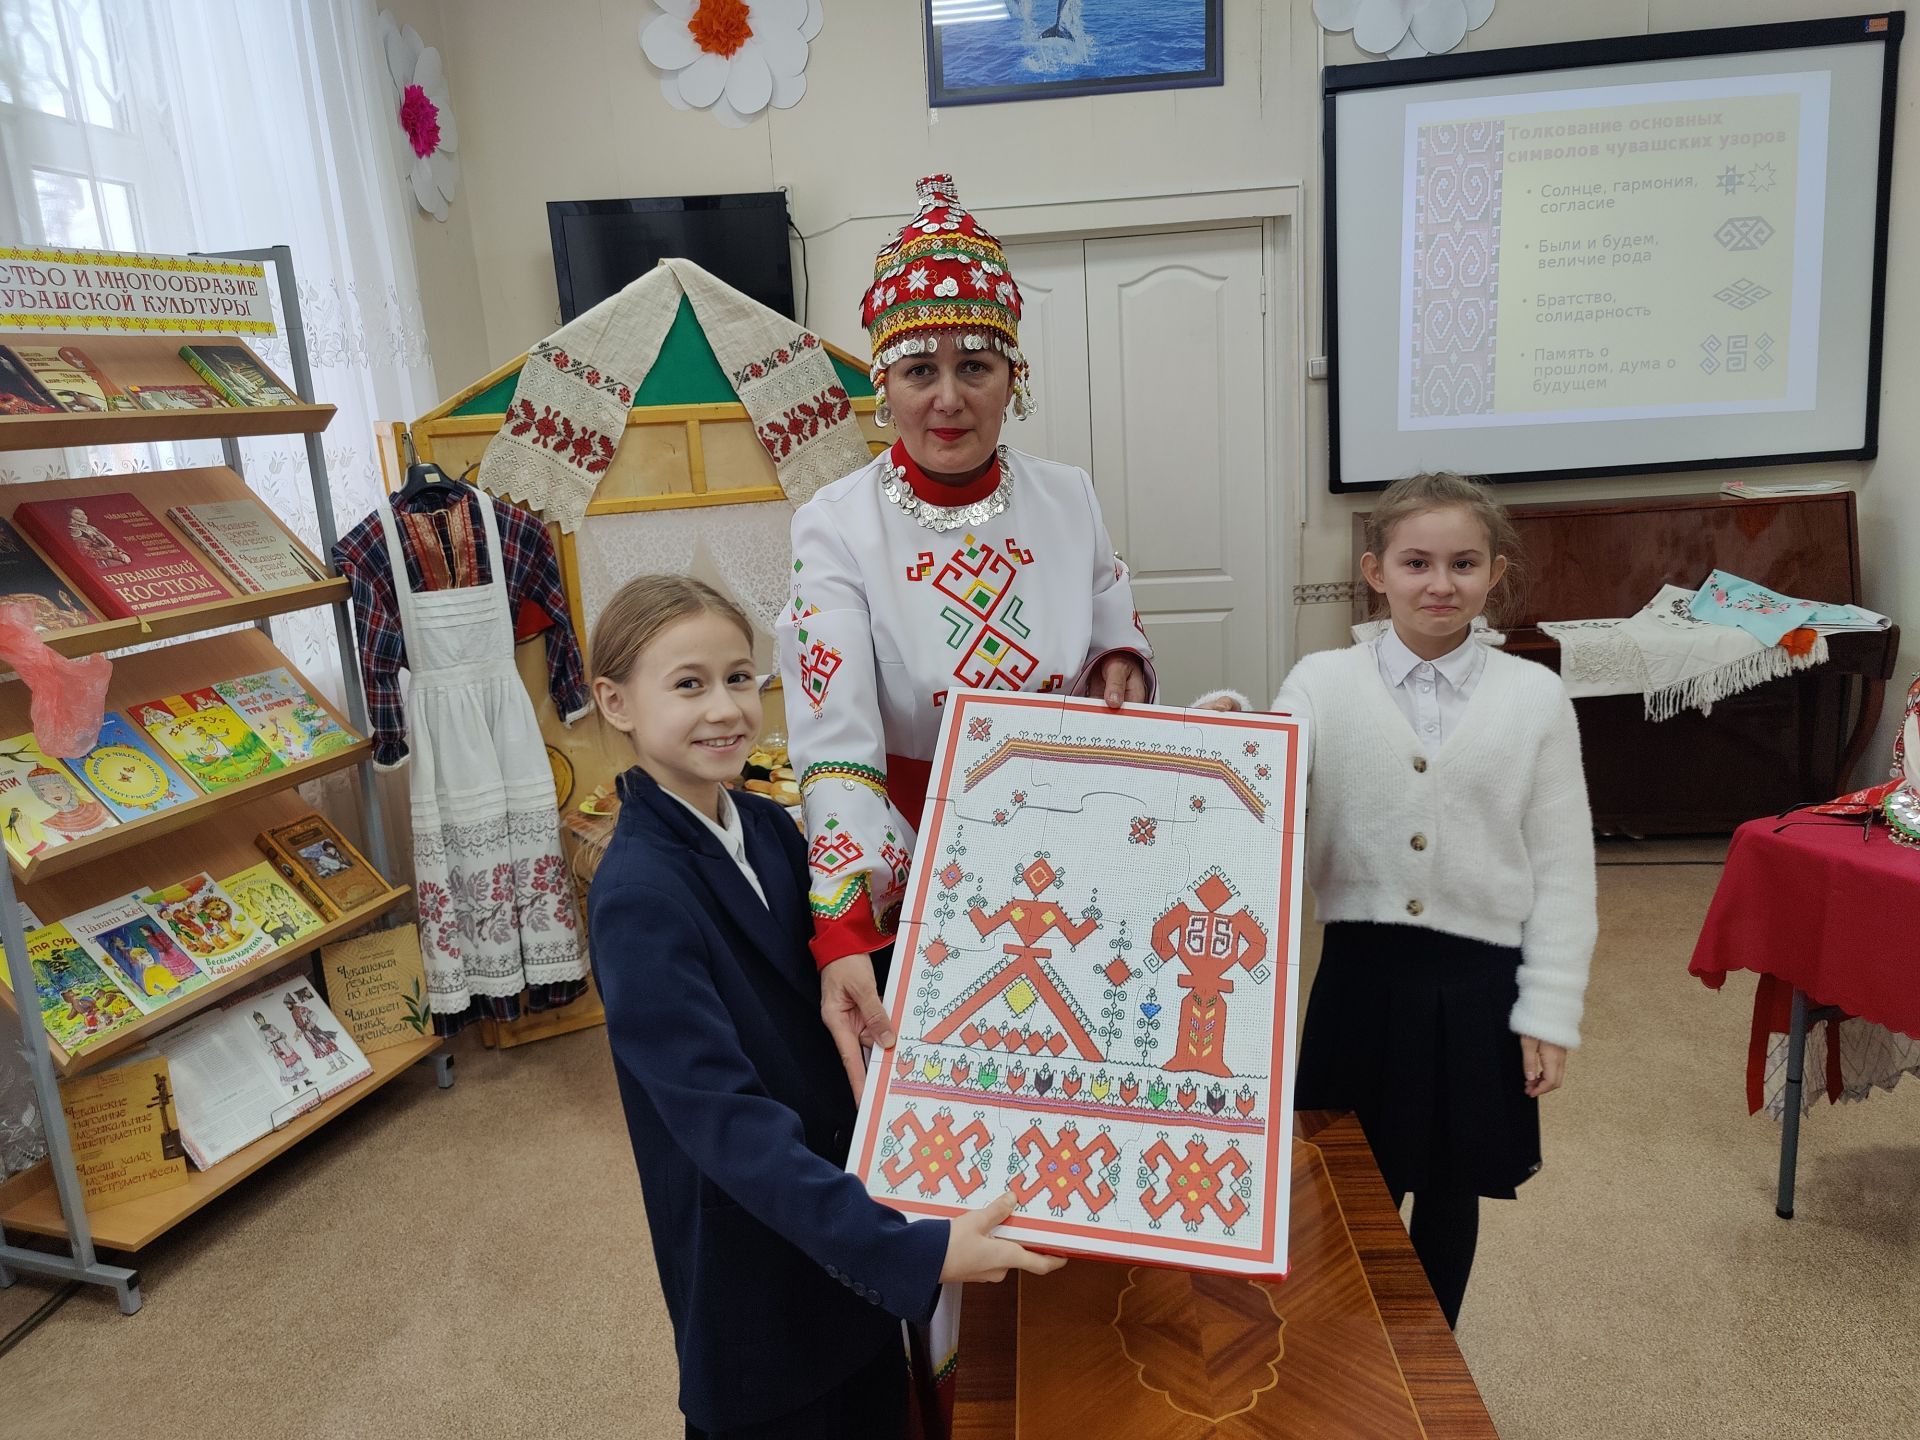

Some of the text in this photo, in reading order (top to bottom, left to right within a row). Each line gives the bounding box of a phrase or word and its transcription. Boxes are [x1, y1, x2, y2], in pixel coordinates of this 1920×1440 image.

[1508, 112, 1724, 141] Толкование основных
[1507, 131, 1787, 163] символов чувашских узоров
[1540, 176, 1698, 198] Солнце, гармония,
[1540, 198, 1616, 214] согласие
[1538, 233, 1659, 253] Были и будем,
[1538, 251, 1652, 269] величие рода
[72, 269, 93, 288] И
[93, 270, 259, 297] МНОГООБРАЗИЕ
[0, 288, 252, 317] УВАШСКОЙ КУЛЬТУРЫ
[1536, 292, 1617, 310] Братство,
[1535, 306, 1652, 323] солидарность
[1534, 347, 1609, 361] Память о
[1533, 358, 1677, 378] прошлом, дума о
[1532, 378, 1607, 395] будущем
[103, 559, 200, 585] ЧУВАШСКИЙ
[115, 574, 216, 603] КОСТЮМ
[337, 960, 397, 980] Чувашская
[345, 973, 383, 992] резьба
[347, 988, 361, 1001] по
[64, 1098, 128, 1120] Чувашские
[73, 1109, 127, 1130] народные
[76, 1112, 153, 1141] музыкальные
[77, 1123, 152, 1151] инструменты
